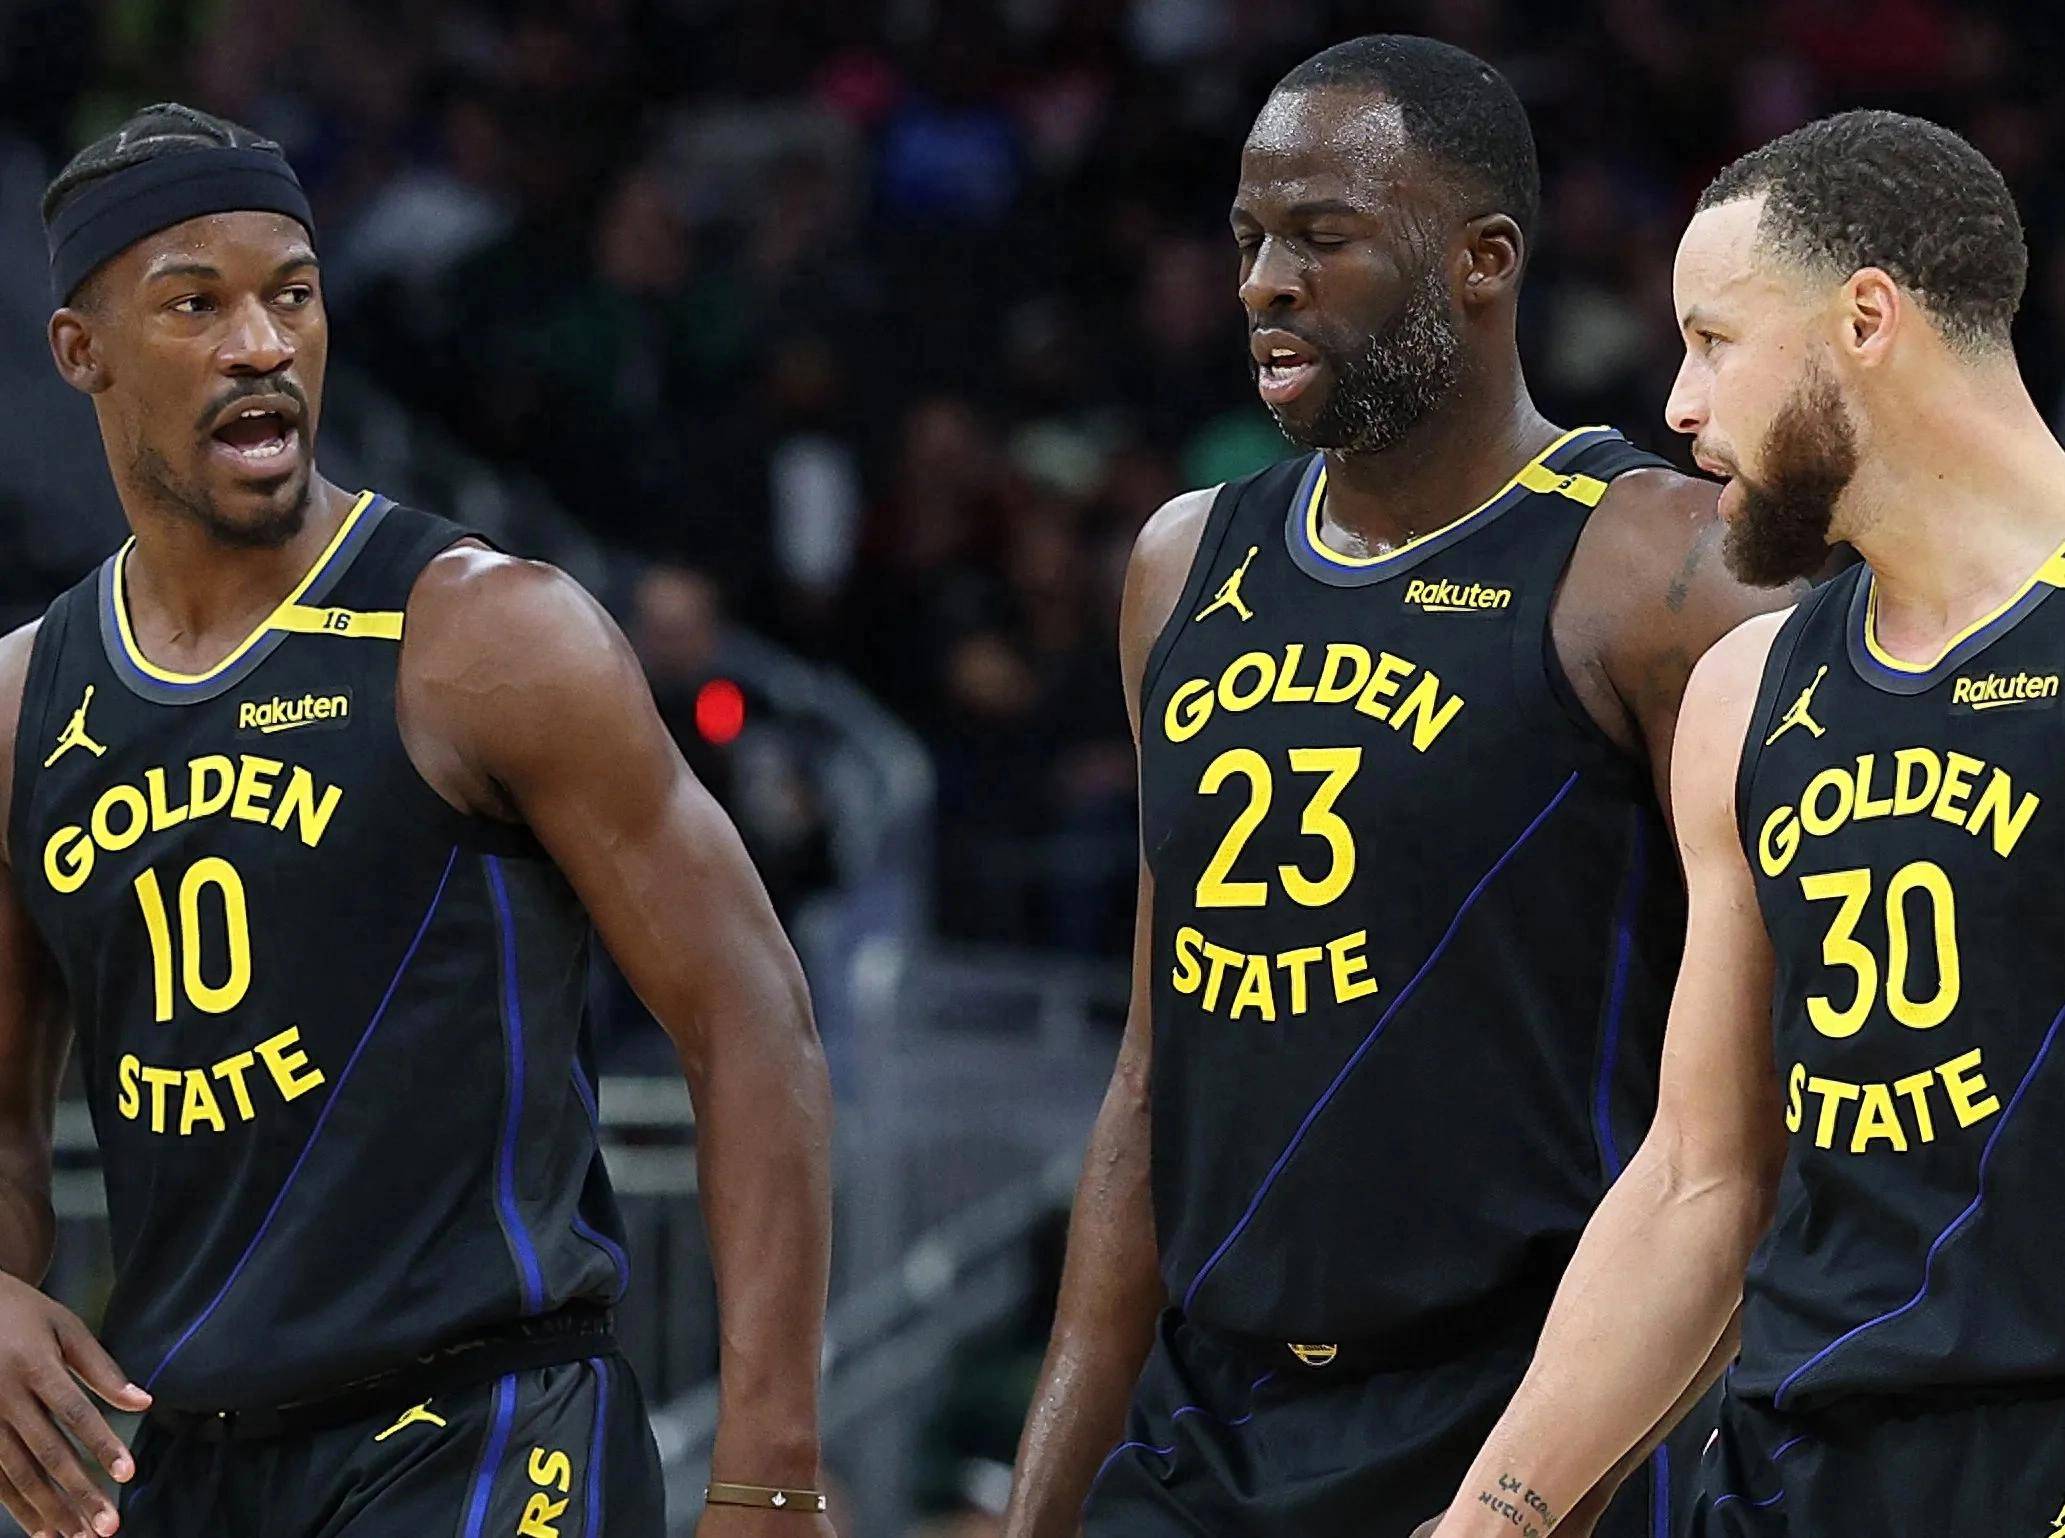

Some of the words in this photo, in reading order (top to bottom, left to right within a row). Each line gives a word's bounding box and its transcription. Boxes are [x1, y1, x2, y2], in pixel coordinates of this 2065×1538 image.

[323, 611, 351, 631] 16
[1404, 578, 1512, 612] Rakuten
[239, 694, 348, 734] Rakuten
[1164, 643, 1465, 753] GOLDEN
[1952, 672, 2059, 711] Rakuten
[43, 754, 343, 894] GOLDEN
[1195, 746, 1363, 908] 23
[1758, 747, 2040, 878] GOLDEN
[133, 856, 251, 1023] 10
[1172, 926, 1379, 1022] STATE
[1799, 860, 1960, 1038] 30
[118, 1025, 326, 1136] STATE
[1785, 1047, 2001, 1153] STATE
[516, 1446, 571, 1538] RS
